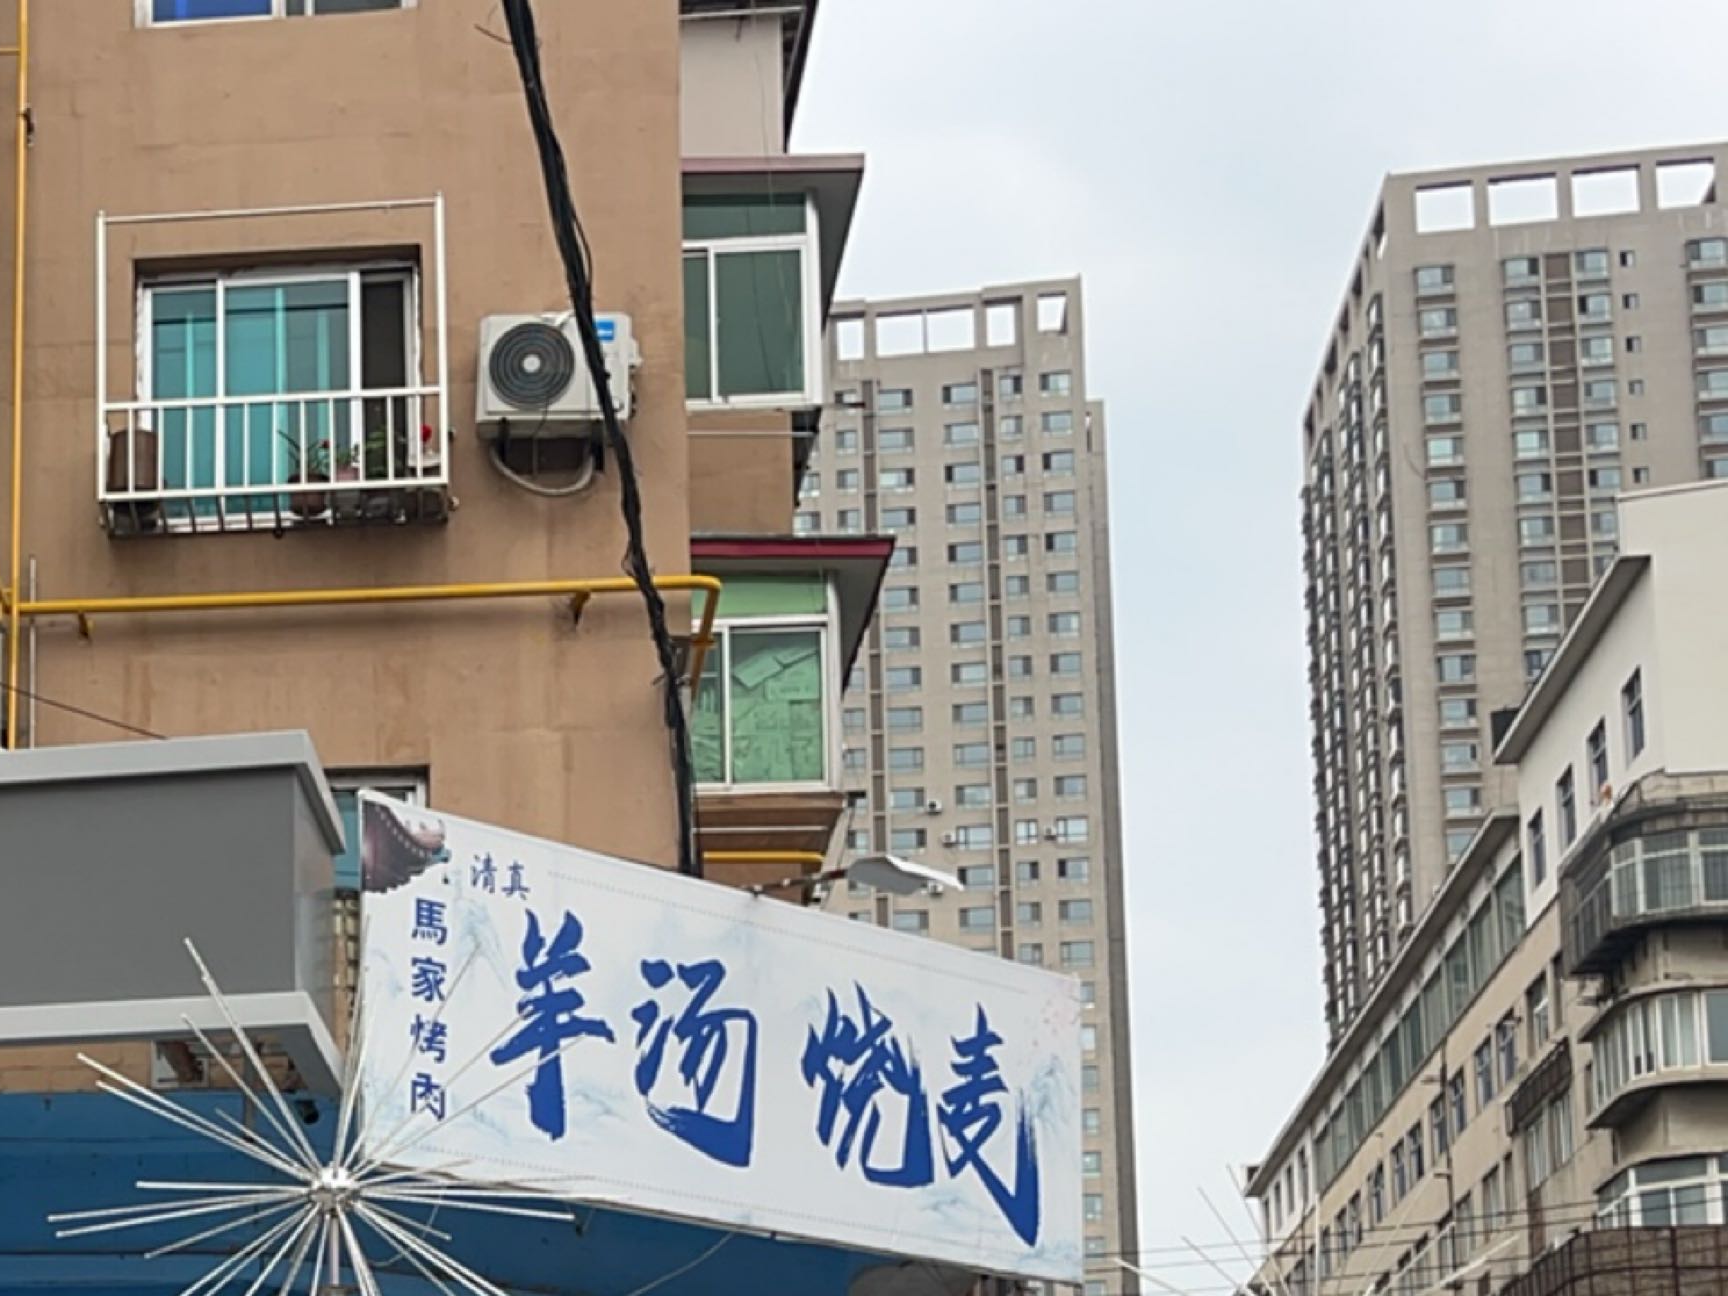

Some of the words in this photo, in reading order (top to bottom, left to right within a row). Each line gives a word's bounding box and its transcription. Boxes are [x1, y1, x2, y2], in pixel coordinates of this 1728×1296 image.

[470, 853, 531, 901] 清真
[408, 898, 449, 1122] 馬家烤肉
[490, 908, 1040, 1248] 羊汤烧麦
